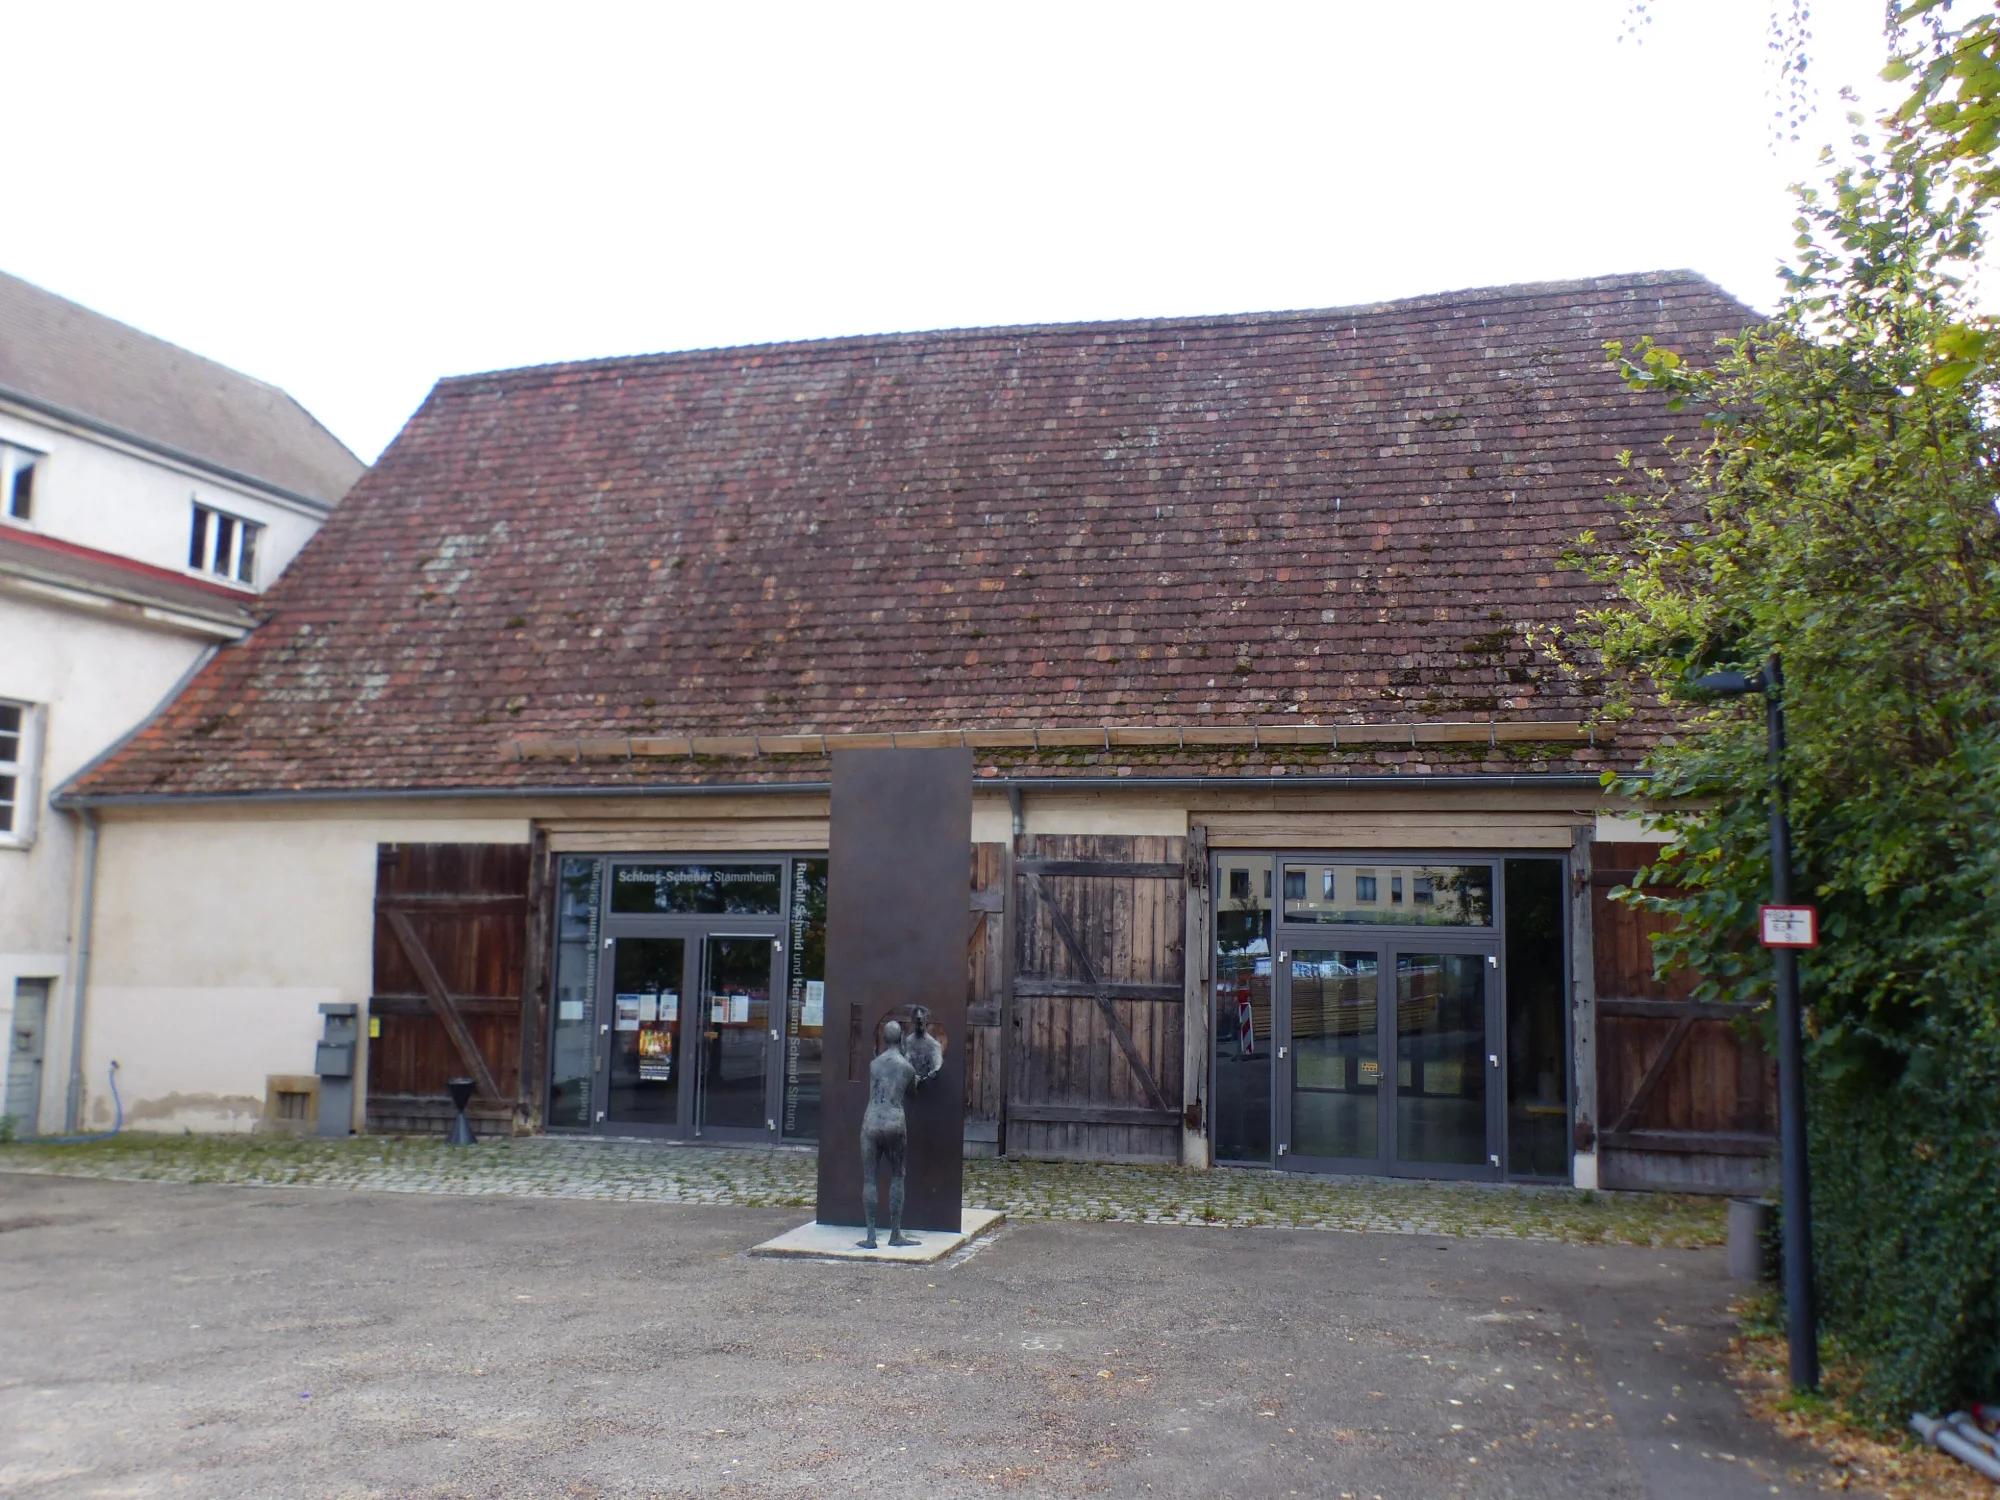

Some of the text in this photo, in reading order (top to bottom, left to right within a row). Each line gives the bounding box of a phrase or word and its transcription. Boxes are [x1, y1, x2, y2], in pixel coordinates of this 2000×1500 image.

[588, 861, 601, 904] Stiftung
[618, 871, 775, 883] Schloss-Scheuer Stammheim
[586, 906, 598, 951] Schmid
[584, 953, 596, 1008] Hermann
[785, 862, 807, 1131] Rudolf Schmid und Hermann Schmid Stiftung
[578, 1081, 590, 1121] Rudolf
